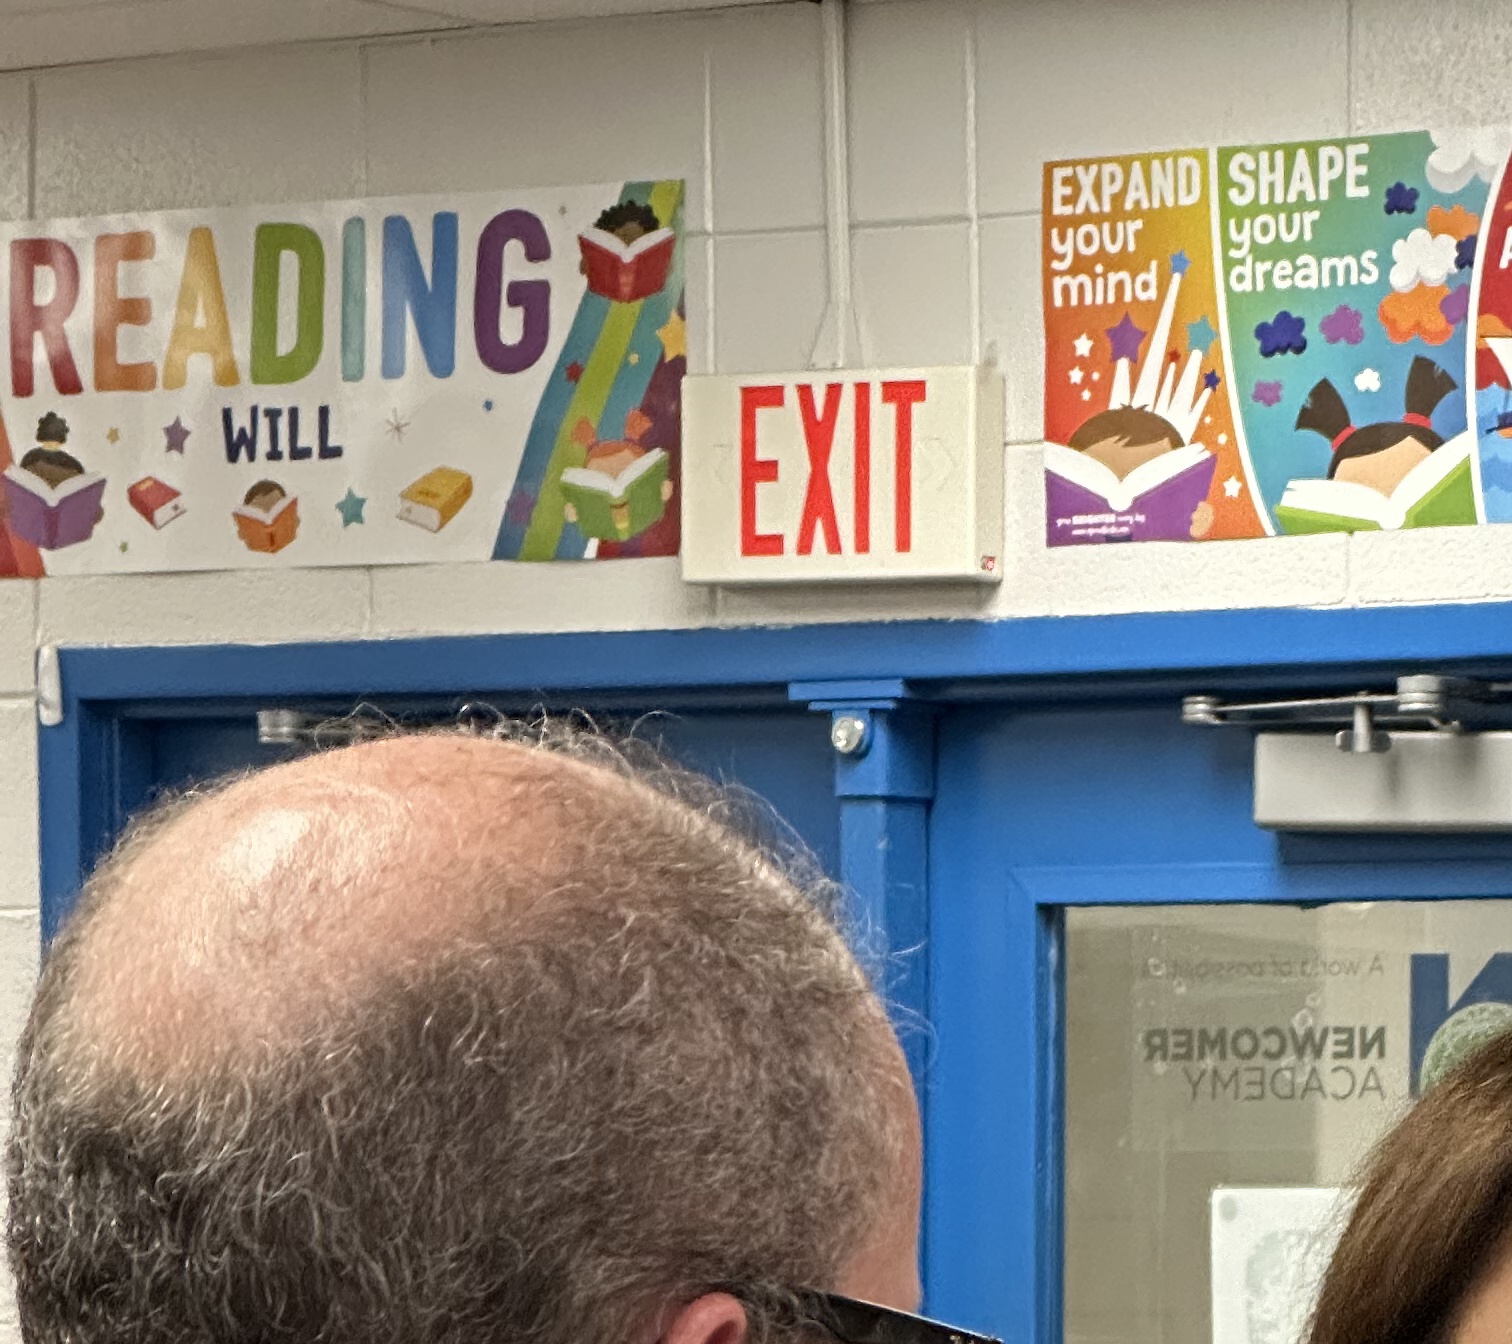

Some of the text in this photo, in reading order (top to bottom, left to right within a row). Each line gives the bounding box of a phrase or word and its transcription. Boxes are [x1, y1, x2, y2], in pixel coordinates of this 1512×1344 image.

[1050, 156, 1201, 216] EXPAND
[1227, 143, 1371, 207] SHAPE
[1050, 217, 1144, 271] your
[1227, 206, 1321, 258] your
[1052, 260, 1158, 308] mind
[1229, 249, 1380, 293] dreams
[9, 208, 552, 398] READING
[221, 404, 344, 464] WILL
[739, 379, 927, 557] EXIT
